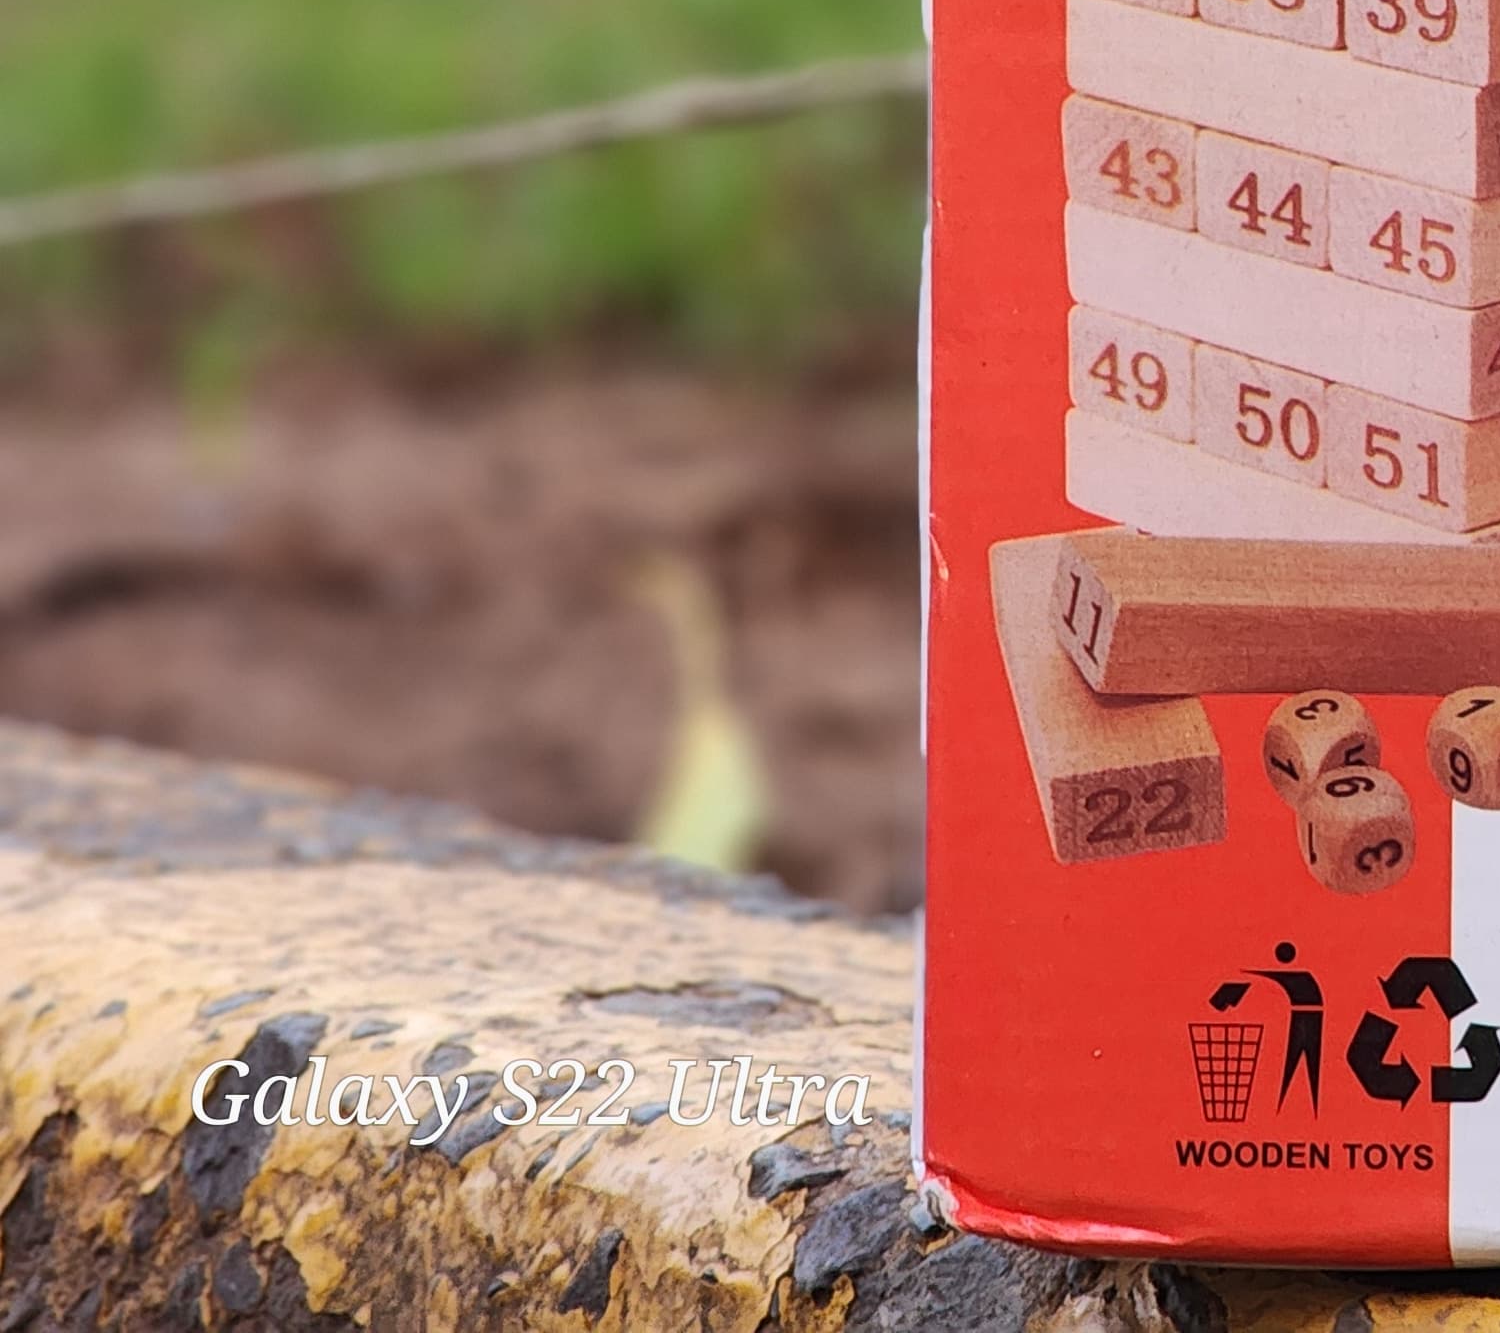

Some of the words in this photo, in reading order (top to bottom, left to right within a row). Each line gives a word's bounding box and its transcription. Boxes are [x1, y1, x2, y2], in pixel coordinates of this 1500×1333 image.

[1097, 139, 1183, 209] 43
[1227, 171, 1313, 246] 44
[1368, 210, 1458, 282] 45
[1086, 341, 1169, 412] 49
[1233, 388, 1321, 463] 50
[1362, 429, 1451, 507] 51
[1062, 571, 1102, 667] 11
[1084, 777, 1192, 844] 22
[1175, 1140, 1330, 1169] WOODEN
[1342, 1143, 1434, 1171] TOYS
